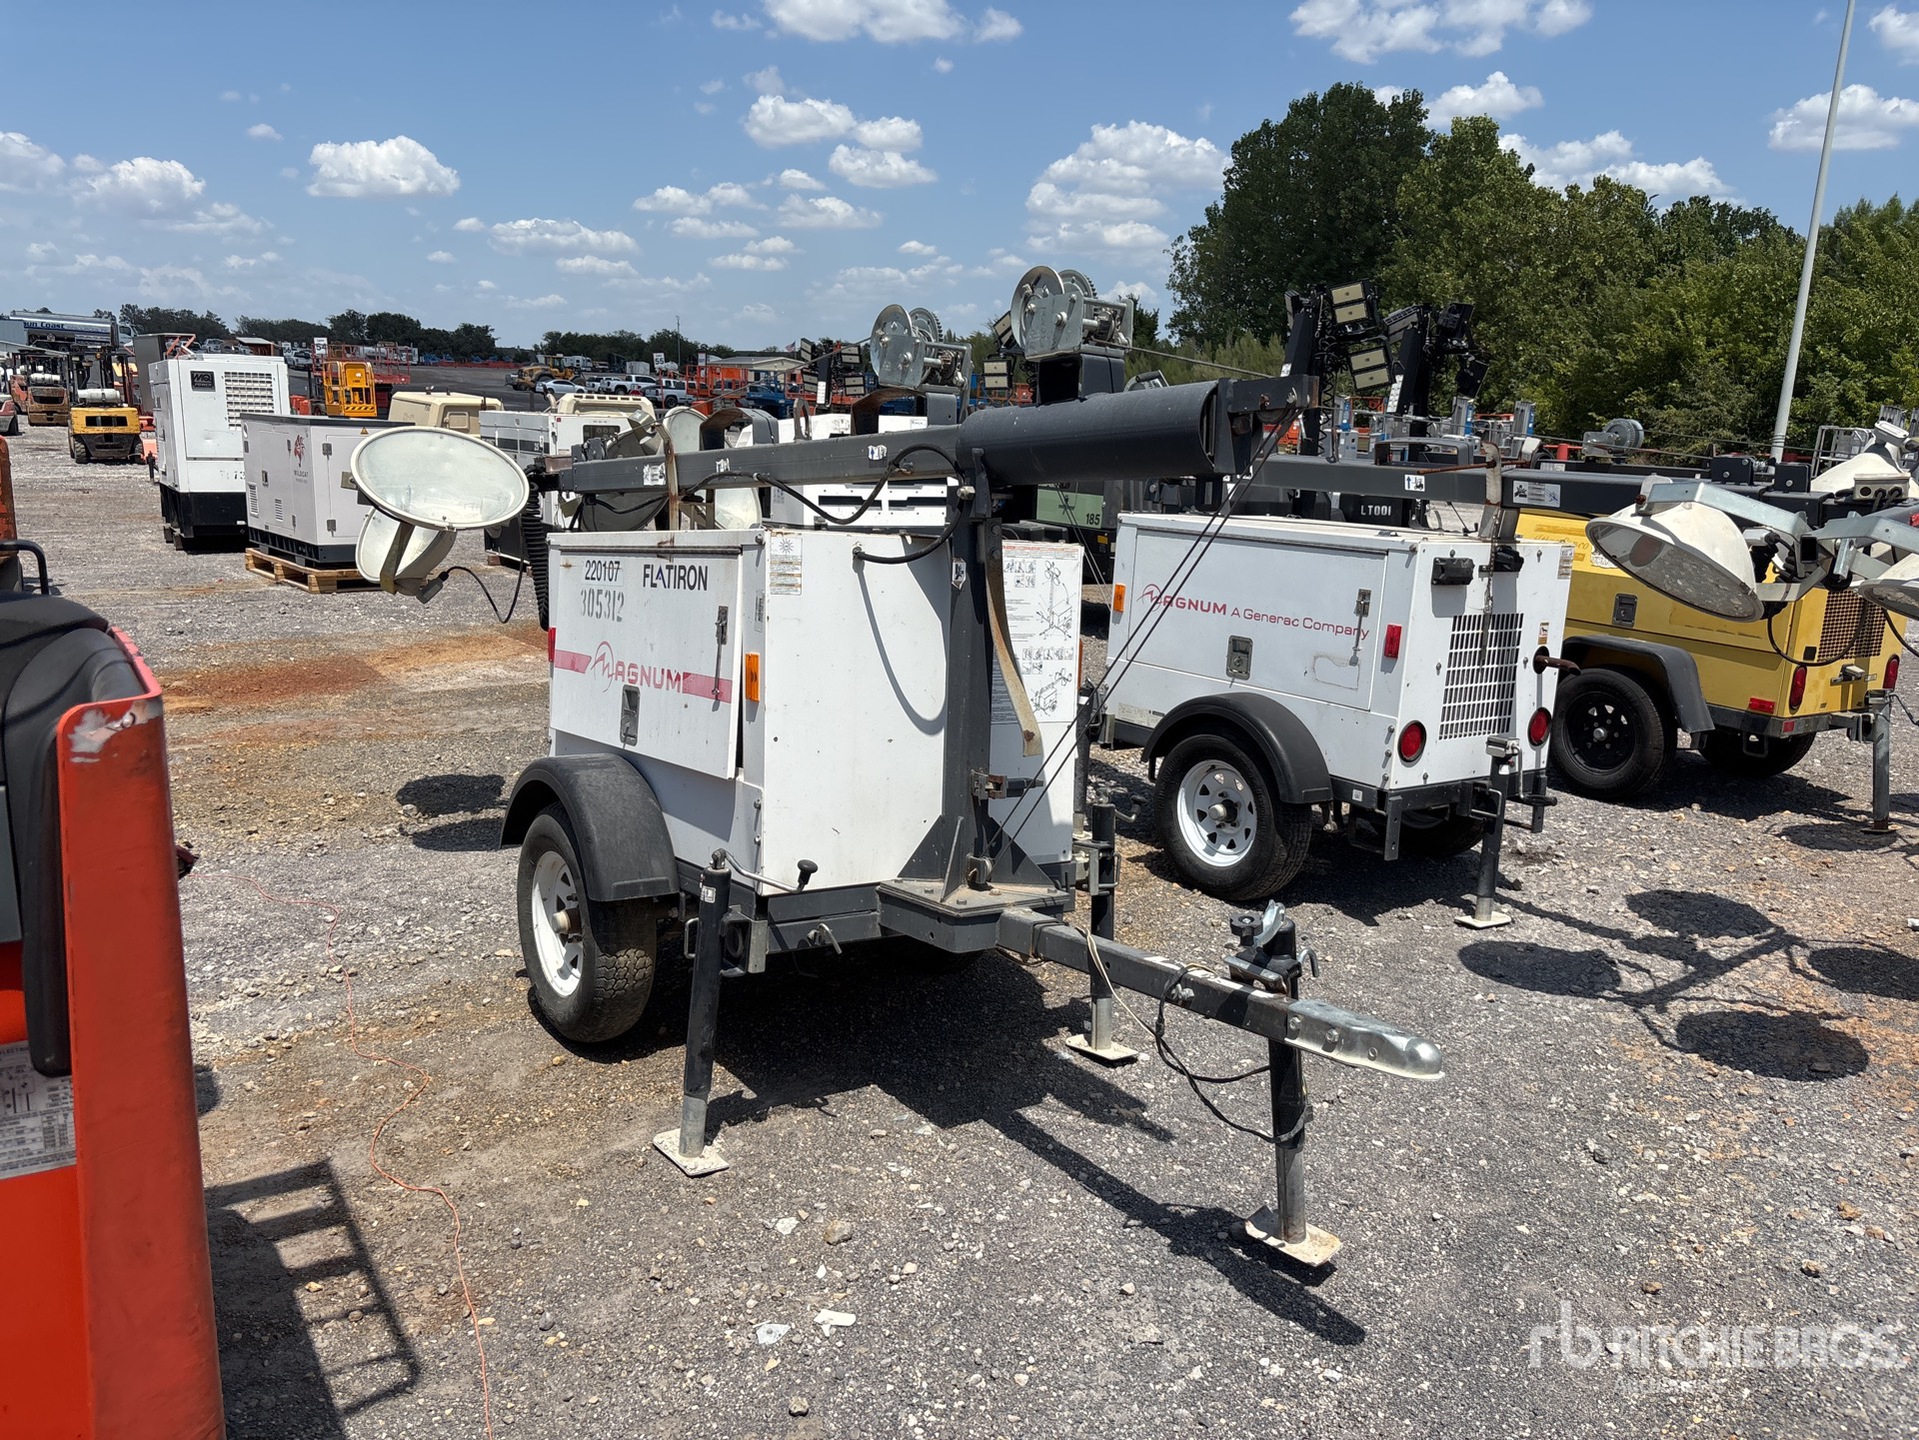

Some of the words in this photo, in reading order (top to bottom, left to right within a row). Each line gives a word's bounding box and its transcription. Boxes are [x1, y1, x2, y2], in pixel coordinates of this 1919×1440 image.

[40, 321, 65, 329] Coast
[316, 343, 327, 351] 54
[655, 357, 664, 365] 55
[193, 373, 212, 382] MQ
[1085, 512, 1101, 526] 185
[584, 559, 621, 582] 220107
[642, 563, 709, 592] FLATIRON
[580, 587, 625, 623] 305312
[1230, 607, 1241, 618] A
[1243, 608, 1300, 628] Generac
[1302, 617, 1369, 641] Company
